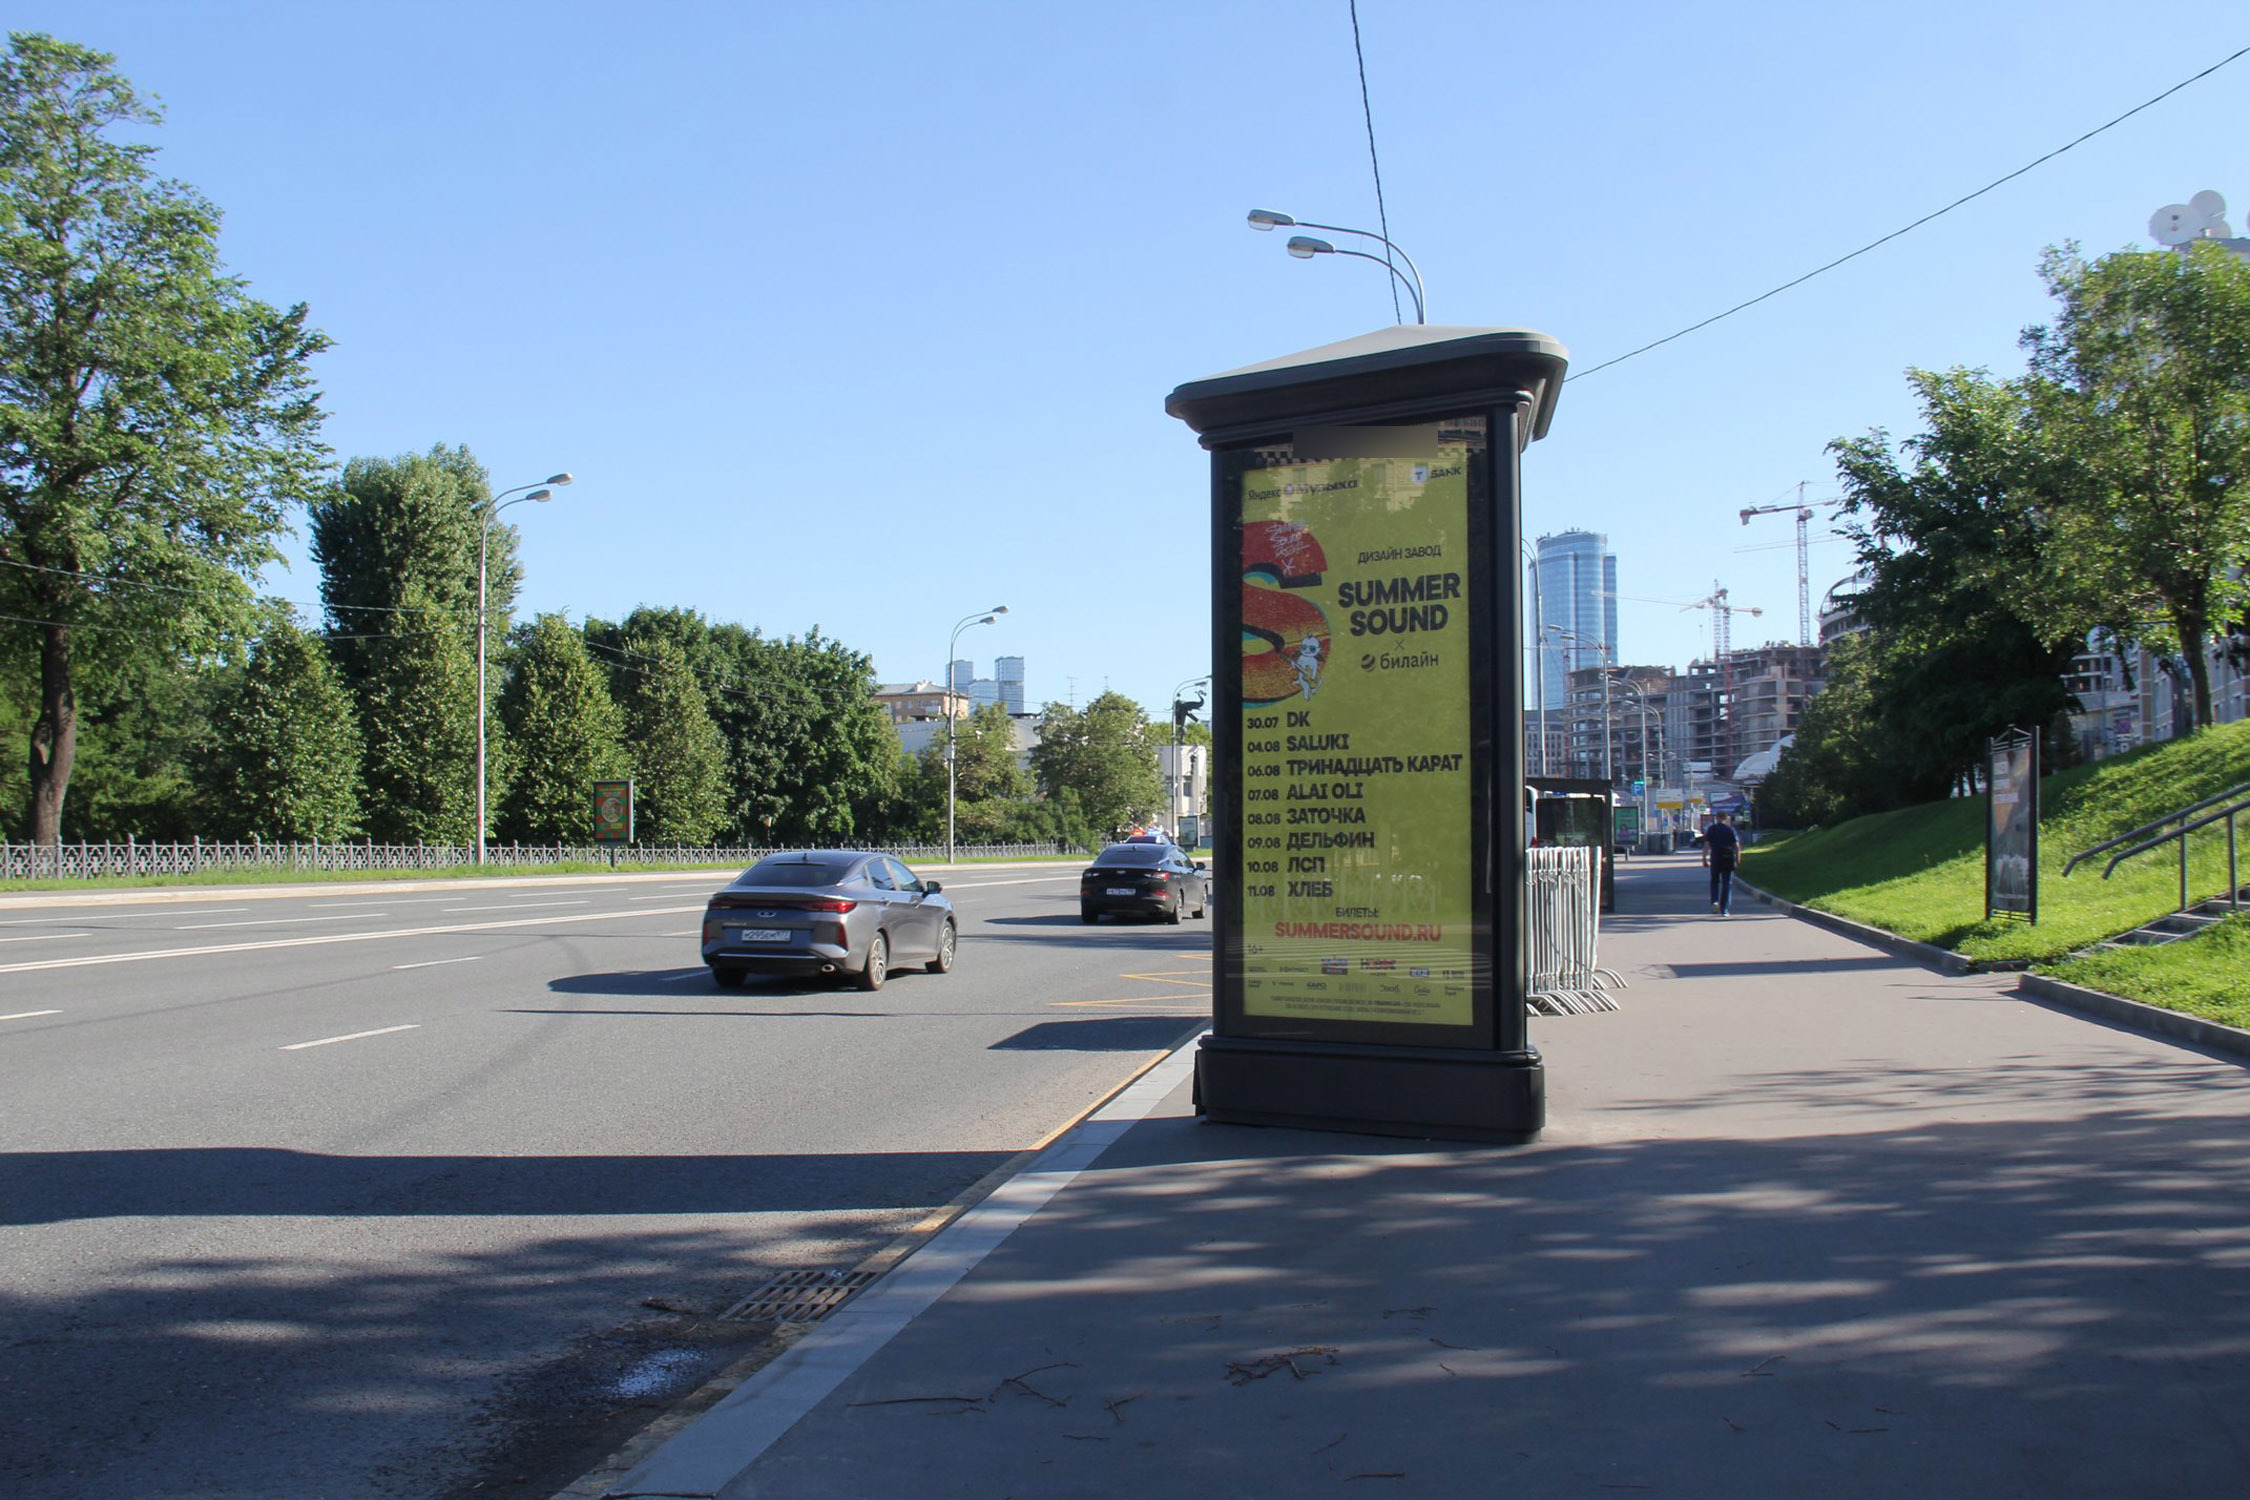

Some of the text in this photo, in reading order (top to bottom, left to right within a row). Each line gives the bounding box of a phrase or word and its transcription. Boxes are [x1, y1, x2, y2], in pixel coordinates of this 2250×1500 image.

[1248, 489, 1281, 501] Яндекс
[1357, 544, 1442, 565] ДИЗАЙН ЗАВОД
[1338, 572, 1461, 608] SUMMER
[1350, 604, 1449, 637] SOUND
[1380, 651, 1439, 670] билайн
[1247, 711, 1311, 729] 30.07 DK
[1247, 734, 1350, 752] 04.08 SALUKI
[1247, 754, 1463, 777] 06.08 ТРИНАДЦАТЬ КАРАТ
[1247, 782, 1363, 801] 07.08 ALAI OLI
[1247, 807, 1366, 825] 08.08 ЗАТОЧКА
[1247, 832, 1375, 851] 09.08 ДЕЛЬФИН
[1247, 856, 1325, 873] 10.08 ЛСП
[1247, 881, 1333, 898] 11.08 ХЛЕБ
[1275, 921, 1442, 942] SUMMERSOUND.RU
